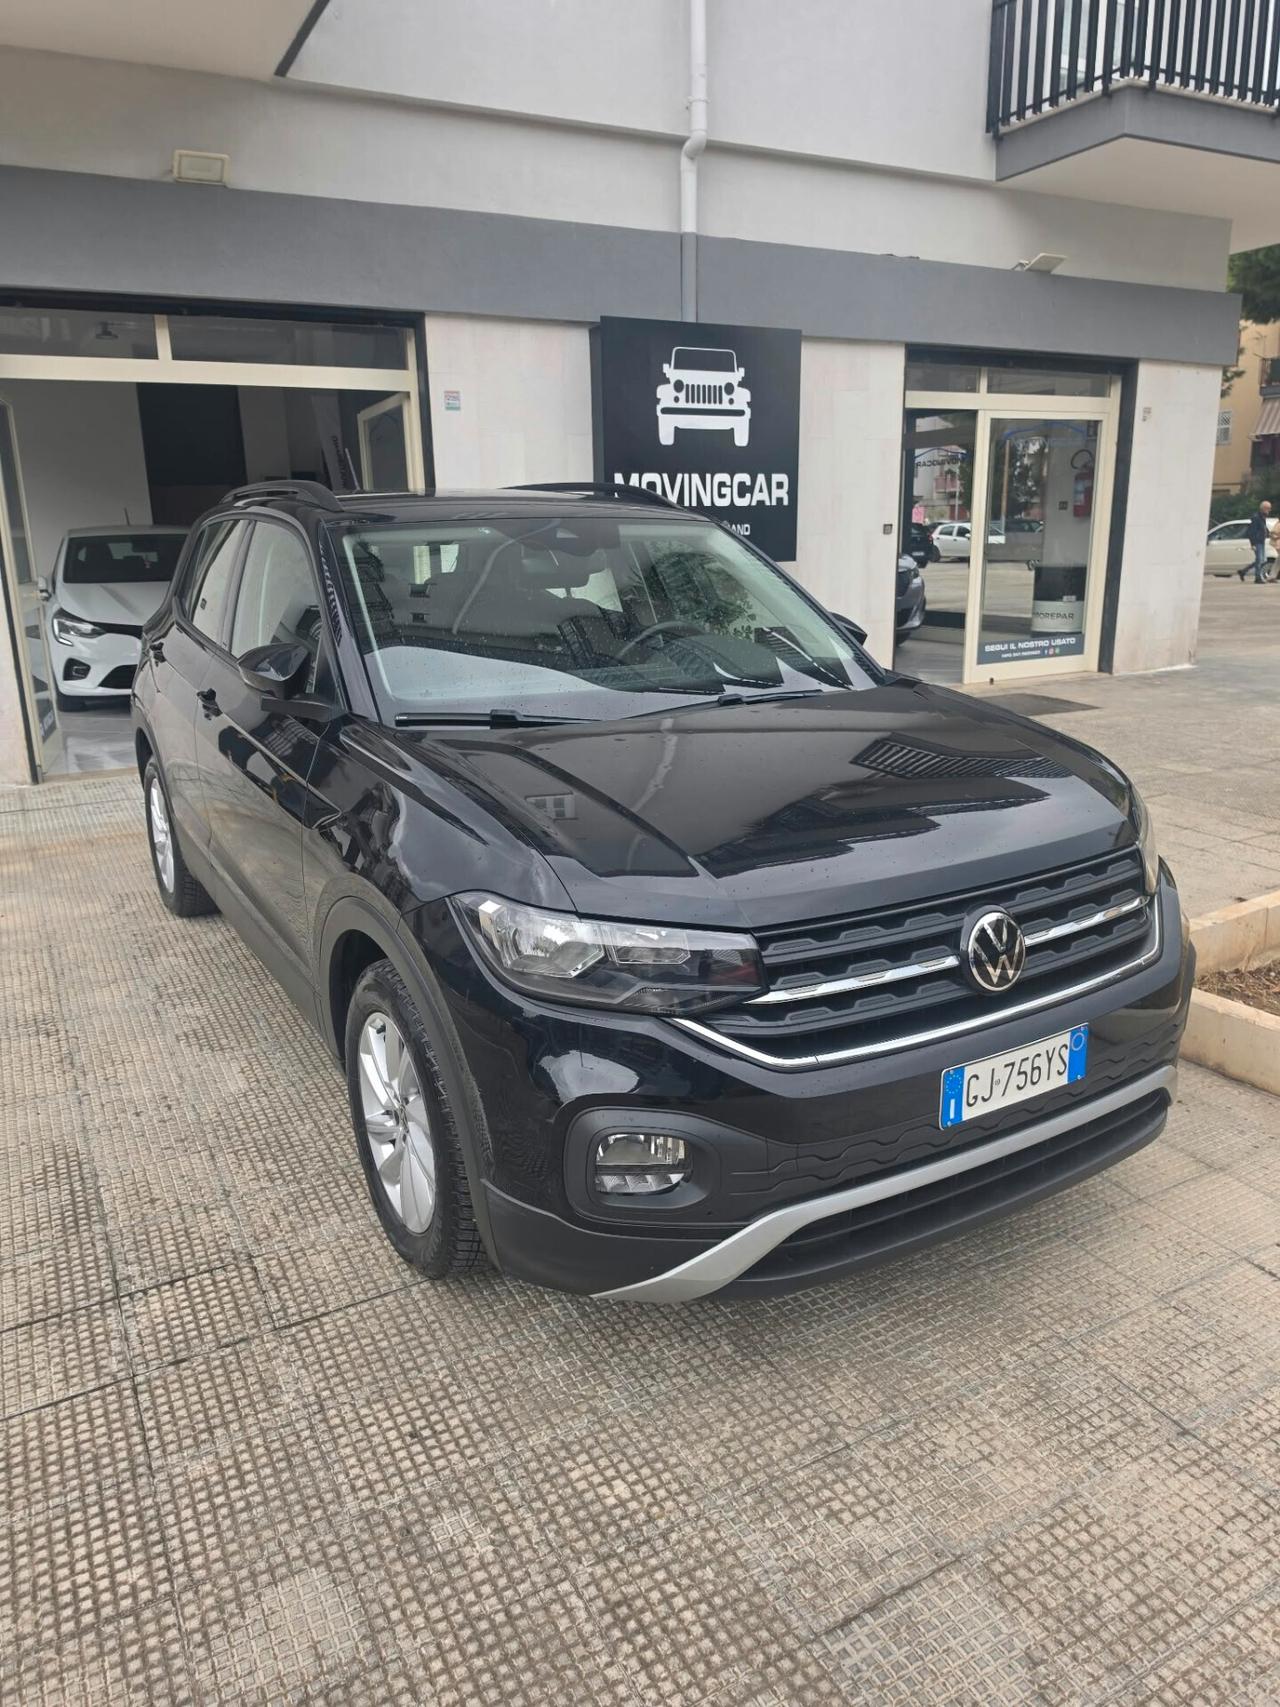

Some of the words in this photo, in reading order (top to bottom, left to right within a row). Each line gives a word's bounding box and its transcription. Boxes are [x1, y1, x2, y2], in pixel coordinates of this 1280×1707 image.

[728, 523, 751, 536] AND
[984, 644, 1008, 652] SEGUI
[1018, 640, 1049, 649] NOSTRO
[1051, 637, 1076, 646] USATO
